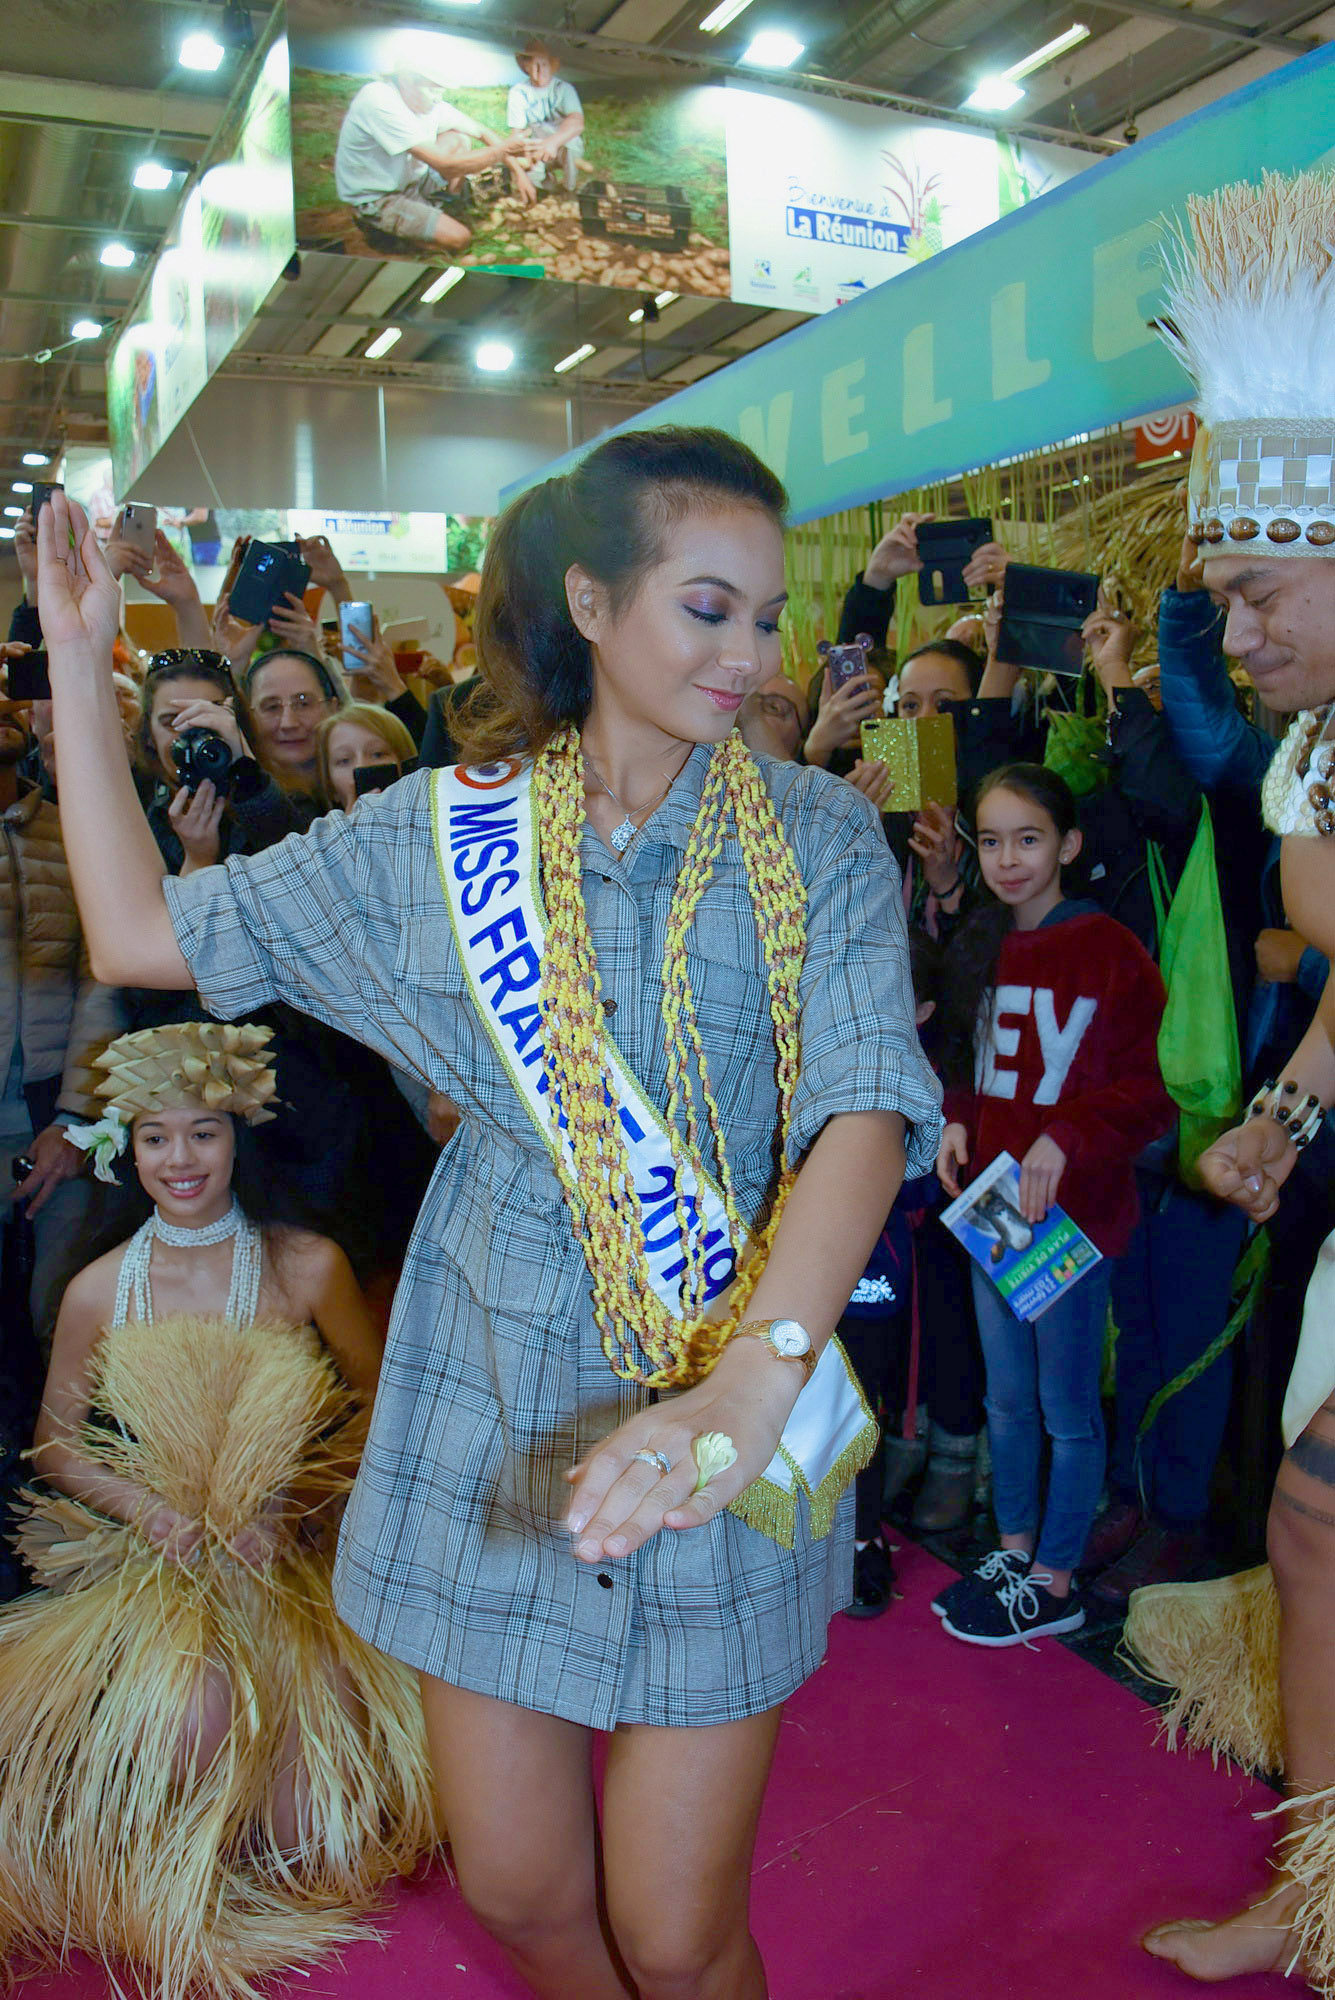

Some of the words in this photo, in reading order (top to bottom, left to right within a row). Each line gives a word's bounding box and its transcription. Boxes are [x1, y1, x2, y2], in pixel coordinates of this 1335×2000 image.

[788, 208, 813, 240] La
[815, 212, 899, 252] Réunion
[449, 796, 520, 917] MISS
[606, 1165, 738, 1305] 2019
